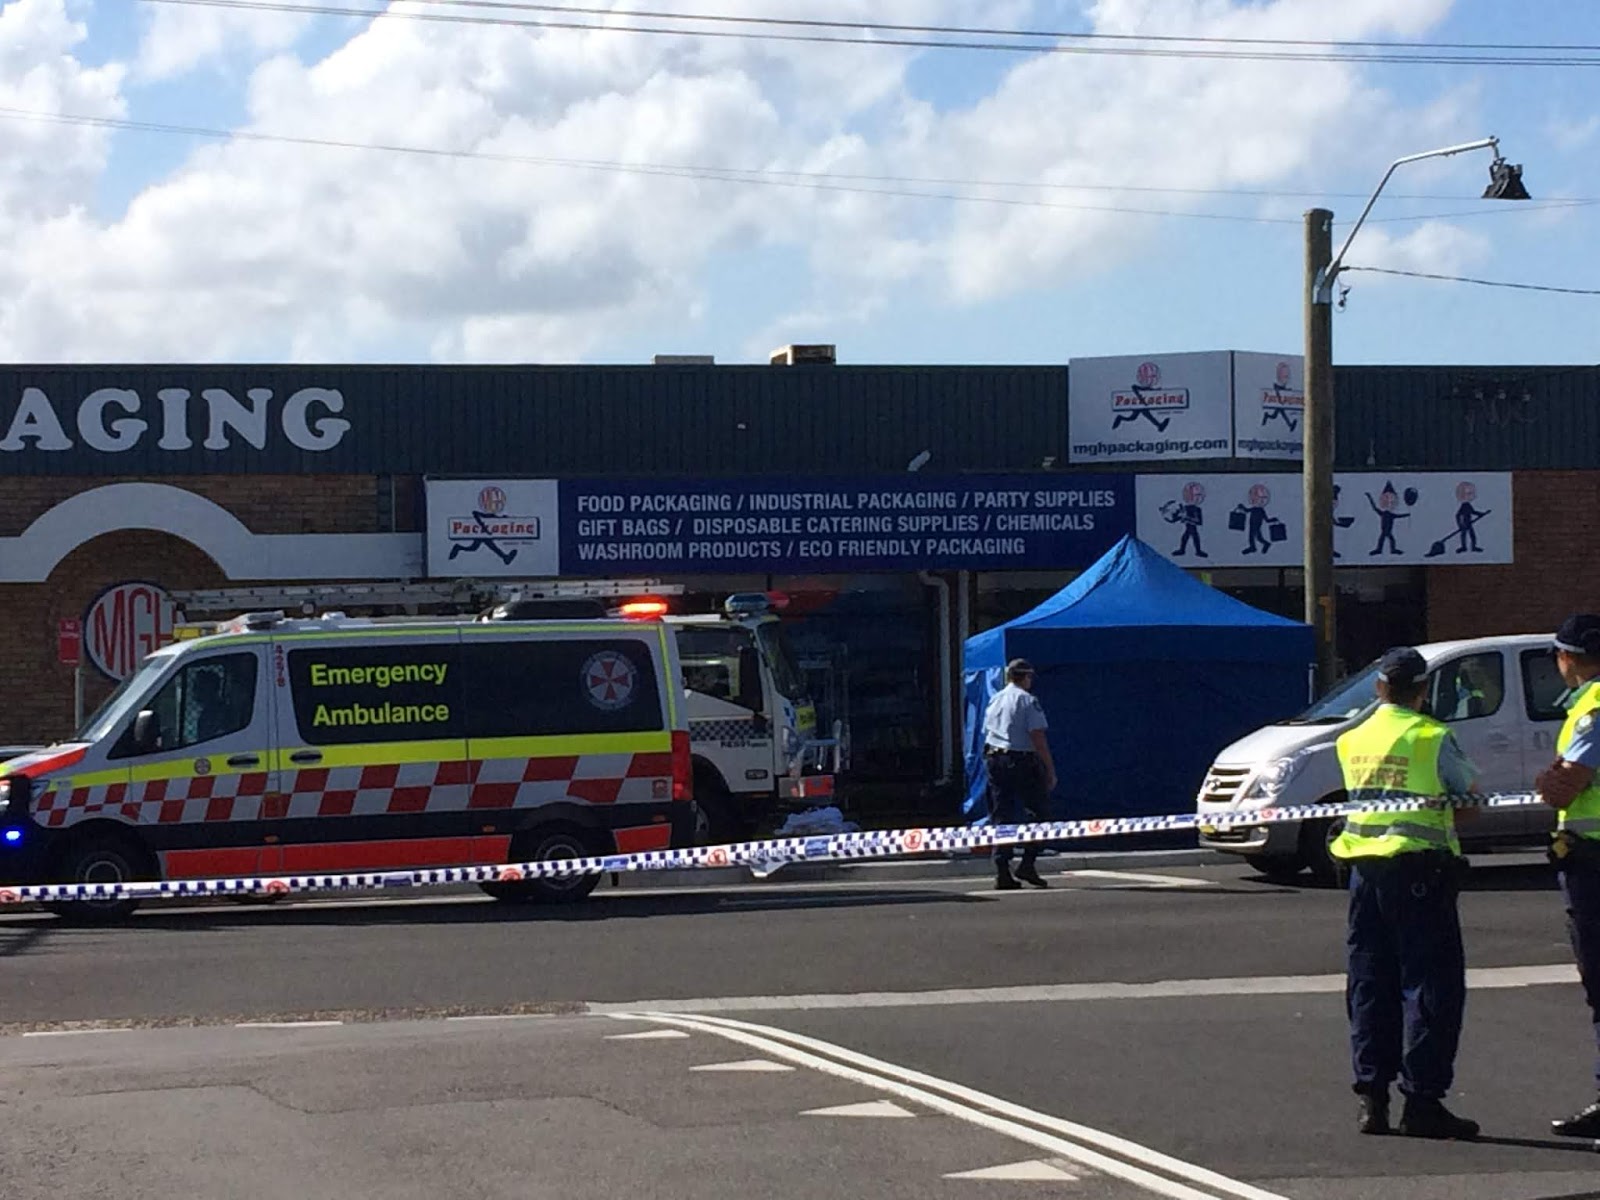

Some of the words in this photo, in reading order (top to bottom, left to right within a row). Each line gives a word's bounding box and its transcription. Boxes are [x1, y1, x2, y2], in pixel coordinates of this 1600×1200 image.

[0, 387, 351, 452] AGING
[1073, 438, 1228, 456] mghpackaging.com
[577, 495, 625, 513] FOOD
[630, 494, 732, 512] PACKAGING
[736, 493, 745, 511] /
[749, 493, 853, 511] INDUSTRIAL
[857, 491, 957, 509] PACKAGING
[961, 491, 970, 509] /
[974, 491, 1030, 508] PARTY
[1034, 490, 1116, 508] SUPPLIES
[452, 521, 534, 536] Packaging
[578, 518, 618, 537] GIFT
[622, 518, 671, 536] BAGS
[674, 518, 683, 536] /
[693, 517, 802, 535] DISPOSABLE
[806, 516, 893, 534] CATERING
[897, 514, 980, 533] SUPPLIES
[983, 514, 992, 532] /
[996, 513, 1095, 531] CHEMICALS
[577, 542, 683, 561] WASHROOM
[688, 540, 782, 559] PRODUCTS
[786, 540, 794, 558] /
[799, 540, 833, 557] ECO
[838, 539, 921, 557] FRIENDLY
[926, 537, 1026, 556] PACKAGING
[310, 663, 448, 687] Emergency
[313, 702, 449, 727] Ambulance
